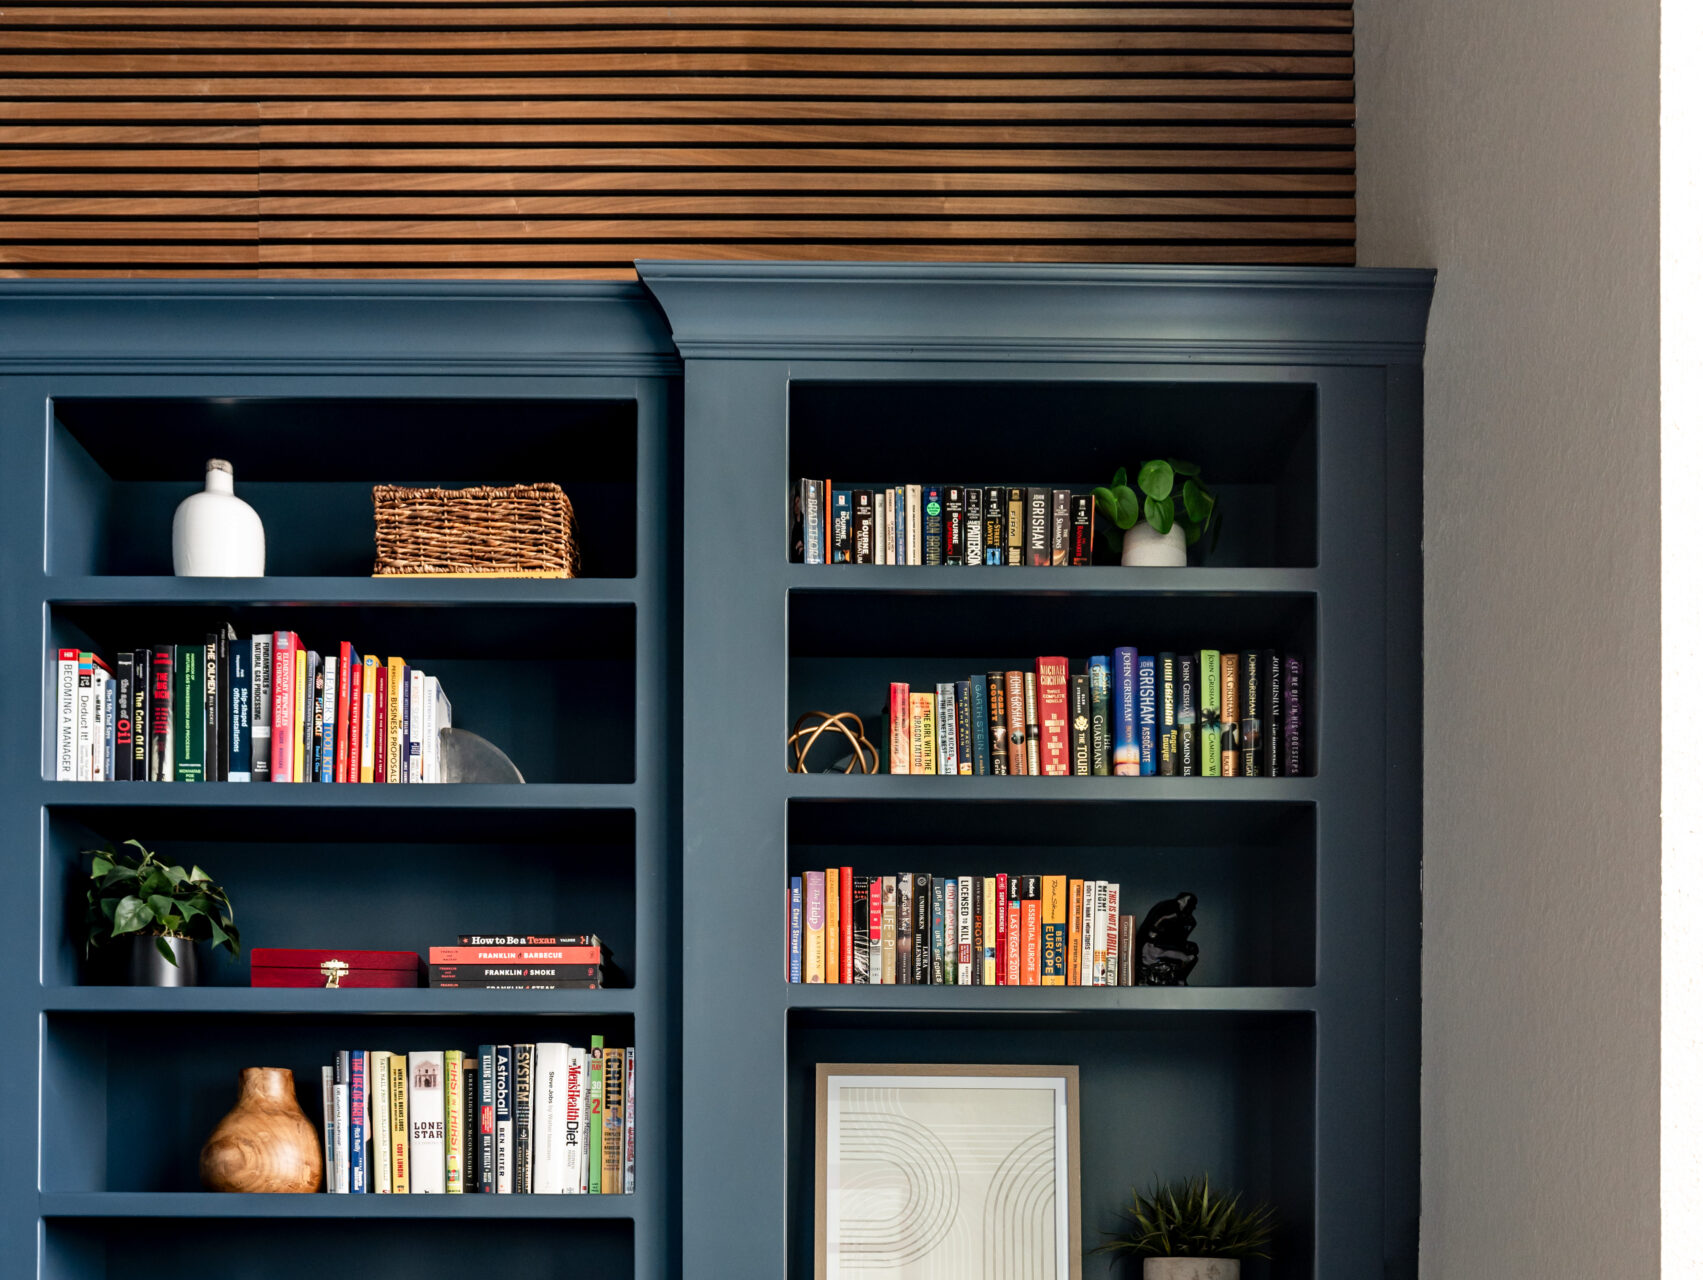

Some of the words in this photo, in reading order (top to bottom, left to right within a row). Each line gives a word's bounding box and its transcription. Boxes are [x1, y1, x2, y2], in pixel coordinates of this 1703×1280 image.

[808, 499, 818, 525] BRAD
[1032, 500, 1044, 549] GRISHAM
[1122, 652, 1131, 676] JOHN
[1226, 656, 1235, 679] JOHN
[63, 664, 72, 714] BECOMING
[120, 679, 129, 692] the
[325, 671, 334, 722] LEADER'S
[1010, 676, 1021, 694] JOHN
[1140, 669, 1154, 724] GRISHAM
[119, 694, 128, 708] age
[136, 691, 144, 707] The
[1226, 681, 1235, 717] GRISHAM
[1249, 678, 1257, 716] GRISHAM
[80, 696, 89, 728] Deduct
[120, 710, 129, 719] of
[136, 710, 144, 733] Color
[965, 718, 969, 727] OF
[1011, 696, 1022, 728] GRISHAM
[80, 732, 89, 740] It!
[117, 720, 131, 744] Oil
[136, 735, 144, 745] Of
[323, 725, 333, 751] TOOL
[1094, 715, 1103, 768] GUARDIANS
[62, 726, 72, 772] MANAGER
[136, 746, 144, 759] Oil
[323, 756, 332, 775] KIT
[810, 901, 821, 924] Help
[884, 908, 894, 930] LIFE
[1108, 913, 1116, 925] NOT
[884, 940, 894, 950] PI
[1045, 926, 1054, 974] EUROPE
[1107, 933, 1116, 956] DRILL
[1056, 956, 1062, 968] OF
[483, 1055, 491, 1078] KILLING
[517, 1053, 529, 1101] SYSTEM
[483, 1080, 491, 1102] LINCOLN
[497, 1055, 508, 1115] Astroball
[605, 1058, 622, 1110] GRILL
[592, 1099, 600, 1114] 2
[414, 1122, 443, 1130] LONE
